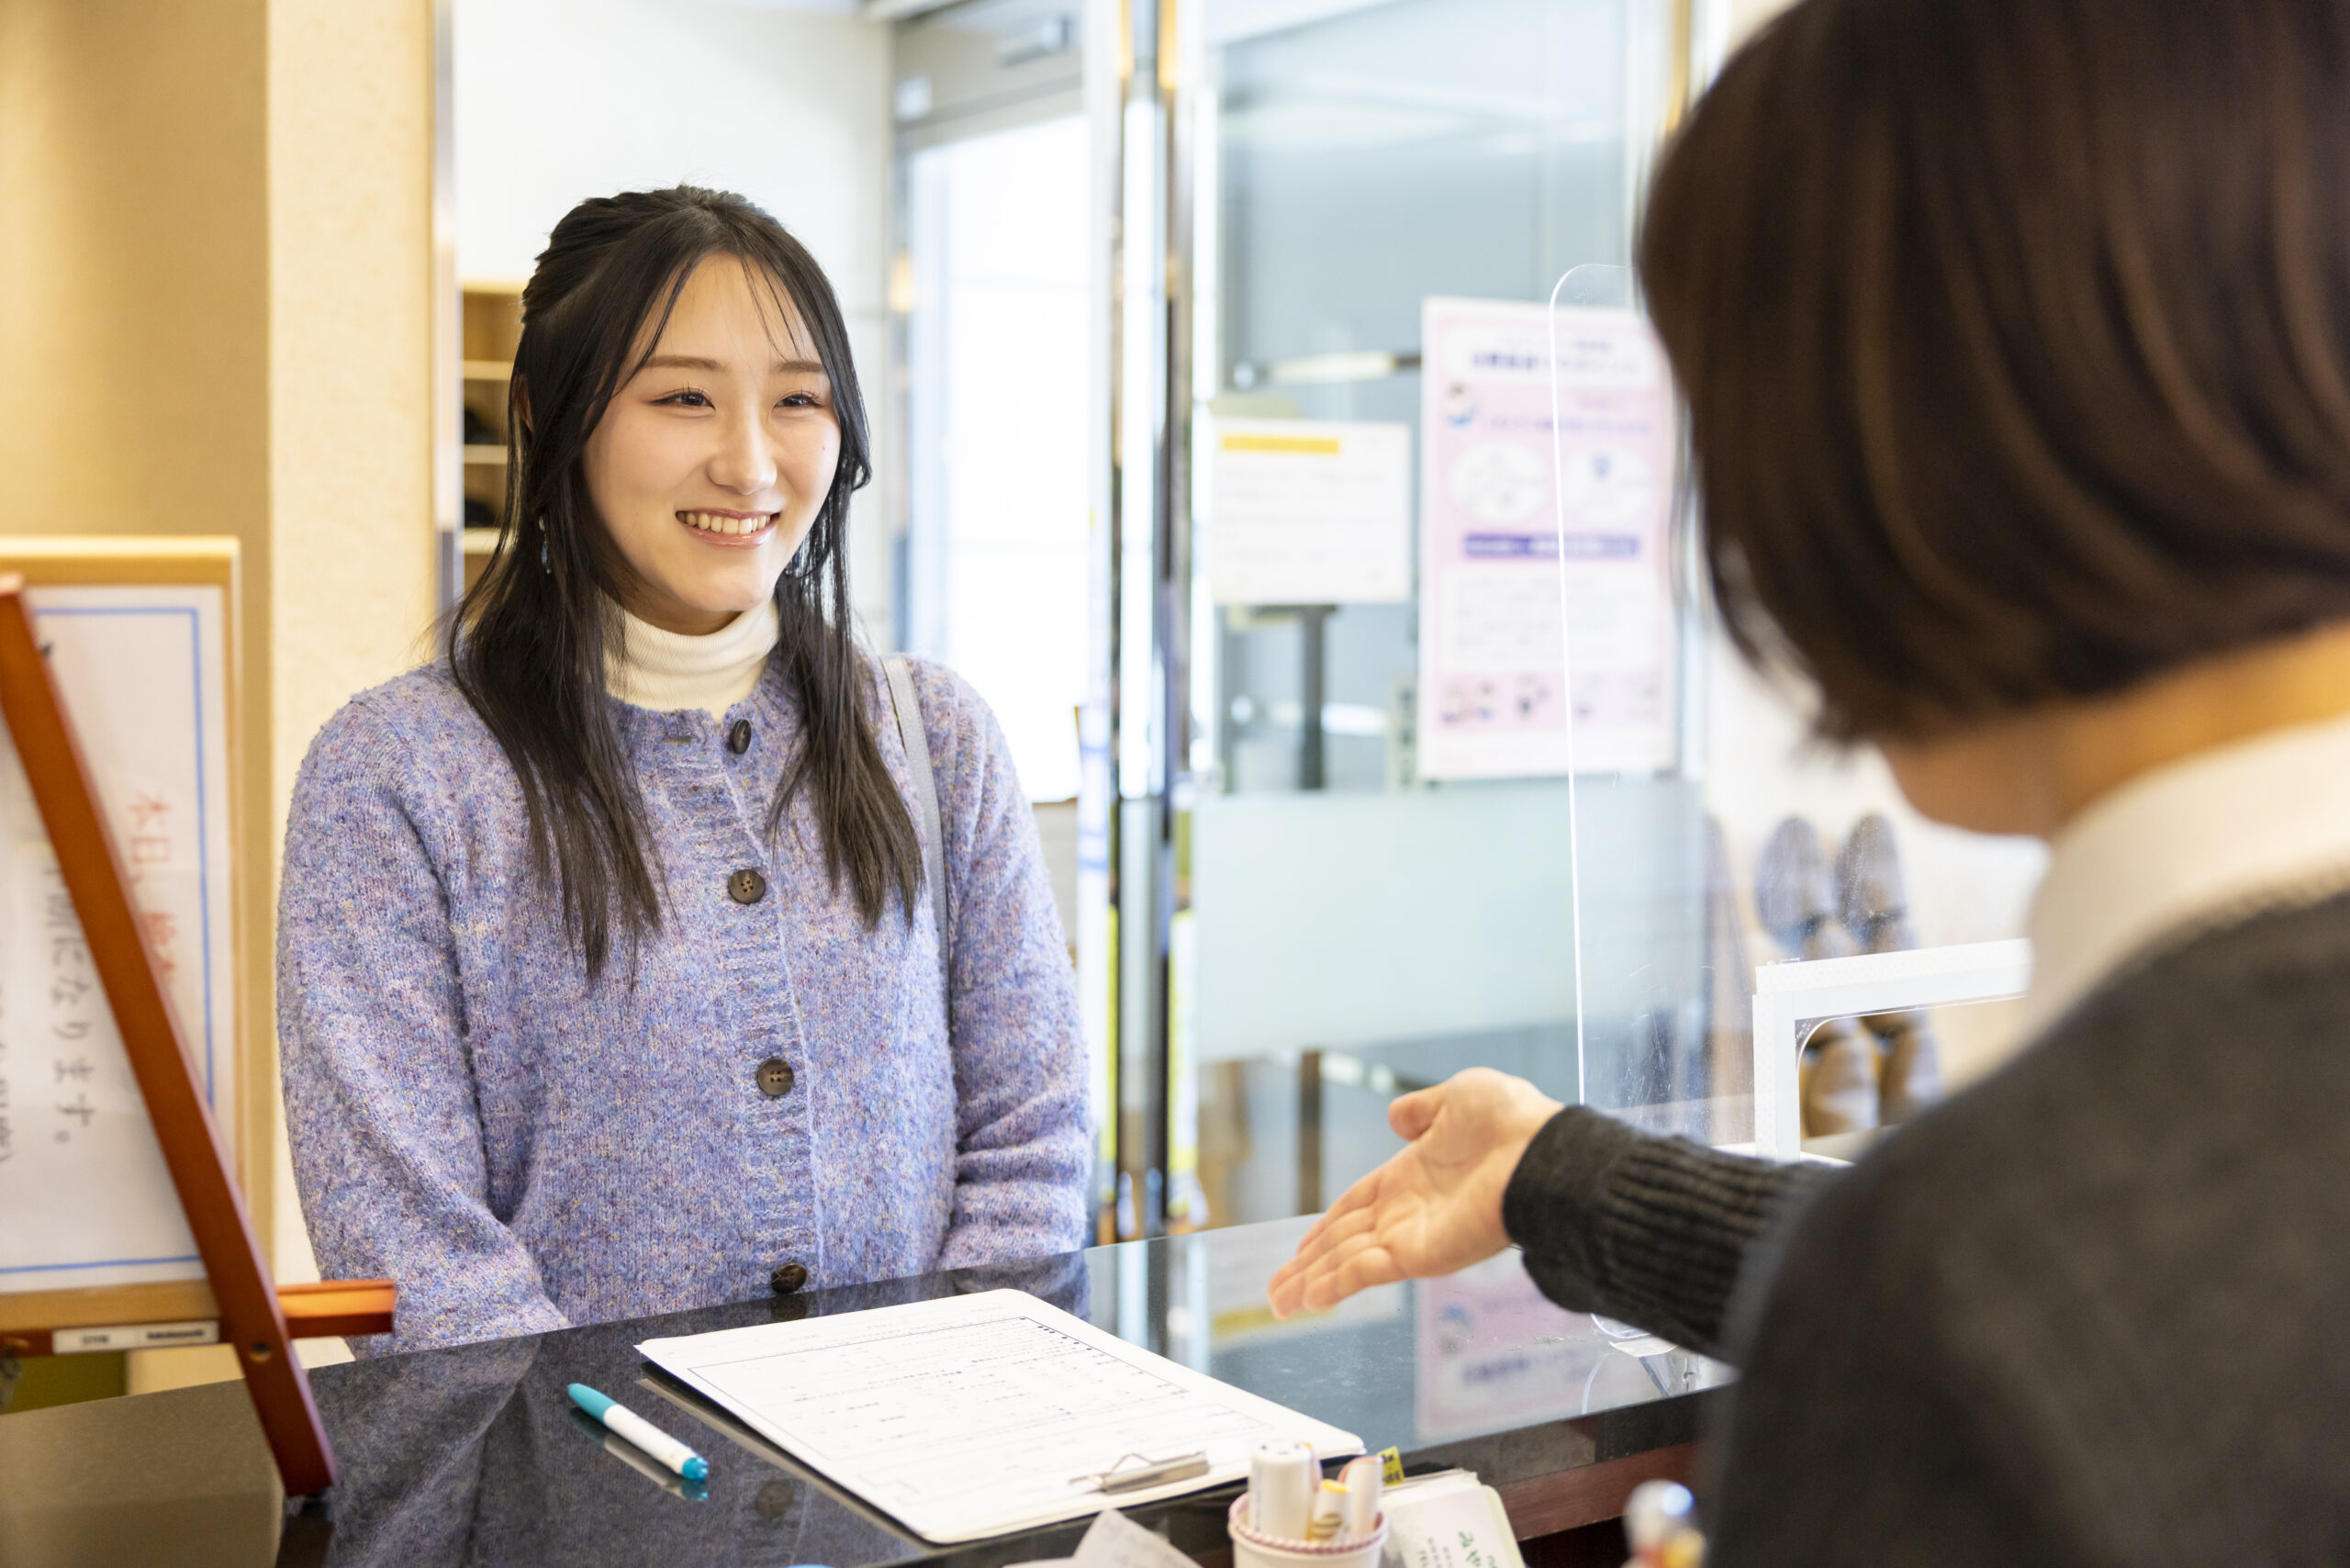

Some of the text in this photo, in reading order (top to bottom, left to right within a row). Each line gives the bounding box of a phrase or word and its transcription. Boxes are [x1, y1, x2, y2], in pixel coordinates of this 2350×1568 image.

[45, 863, 95, 1145] になります。
